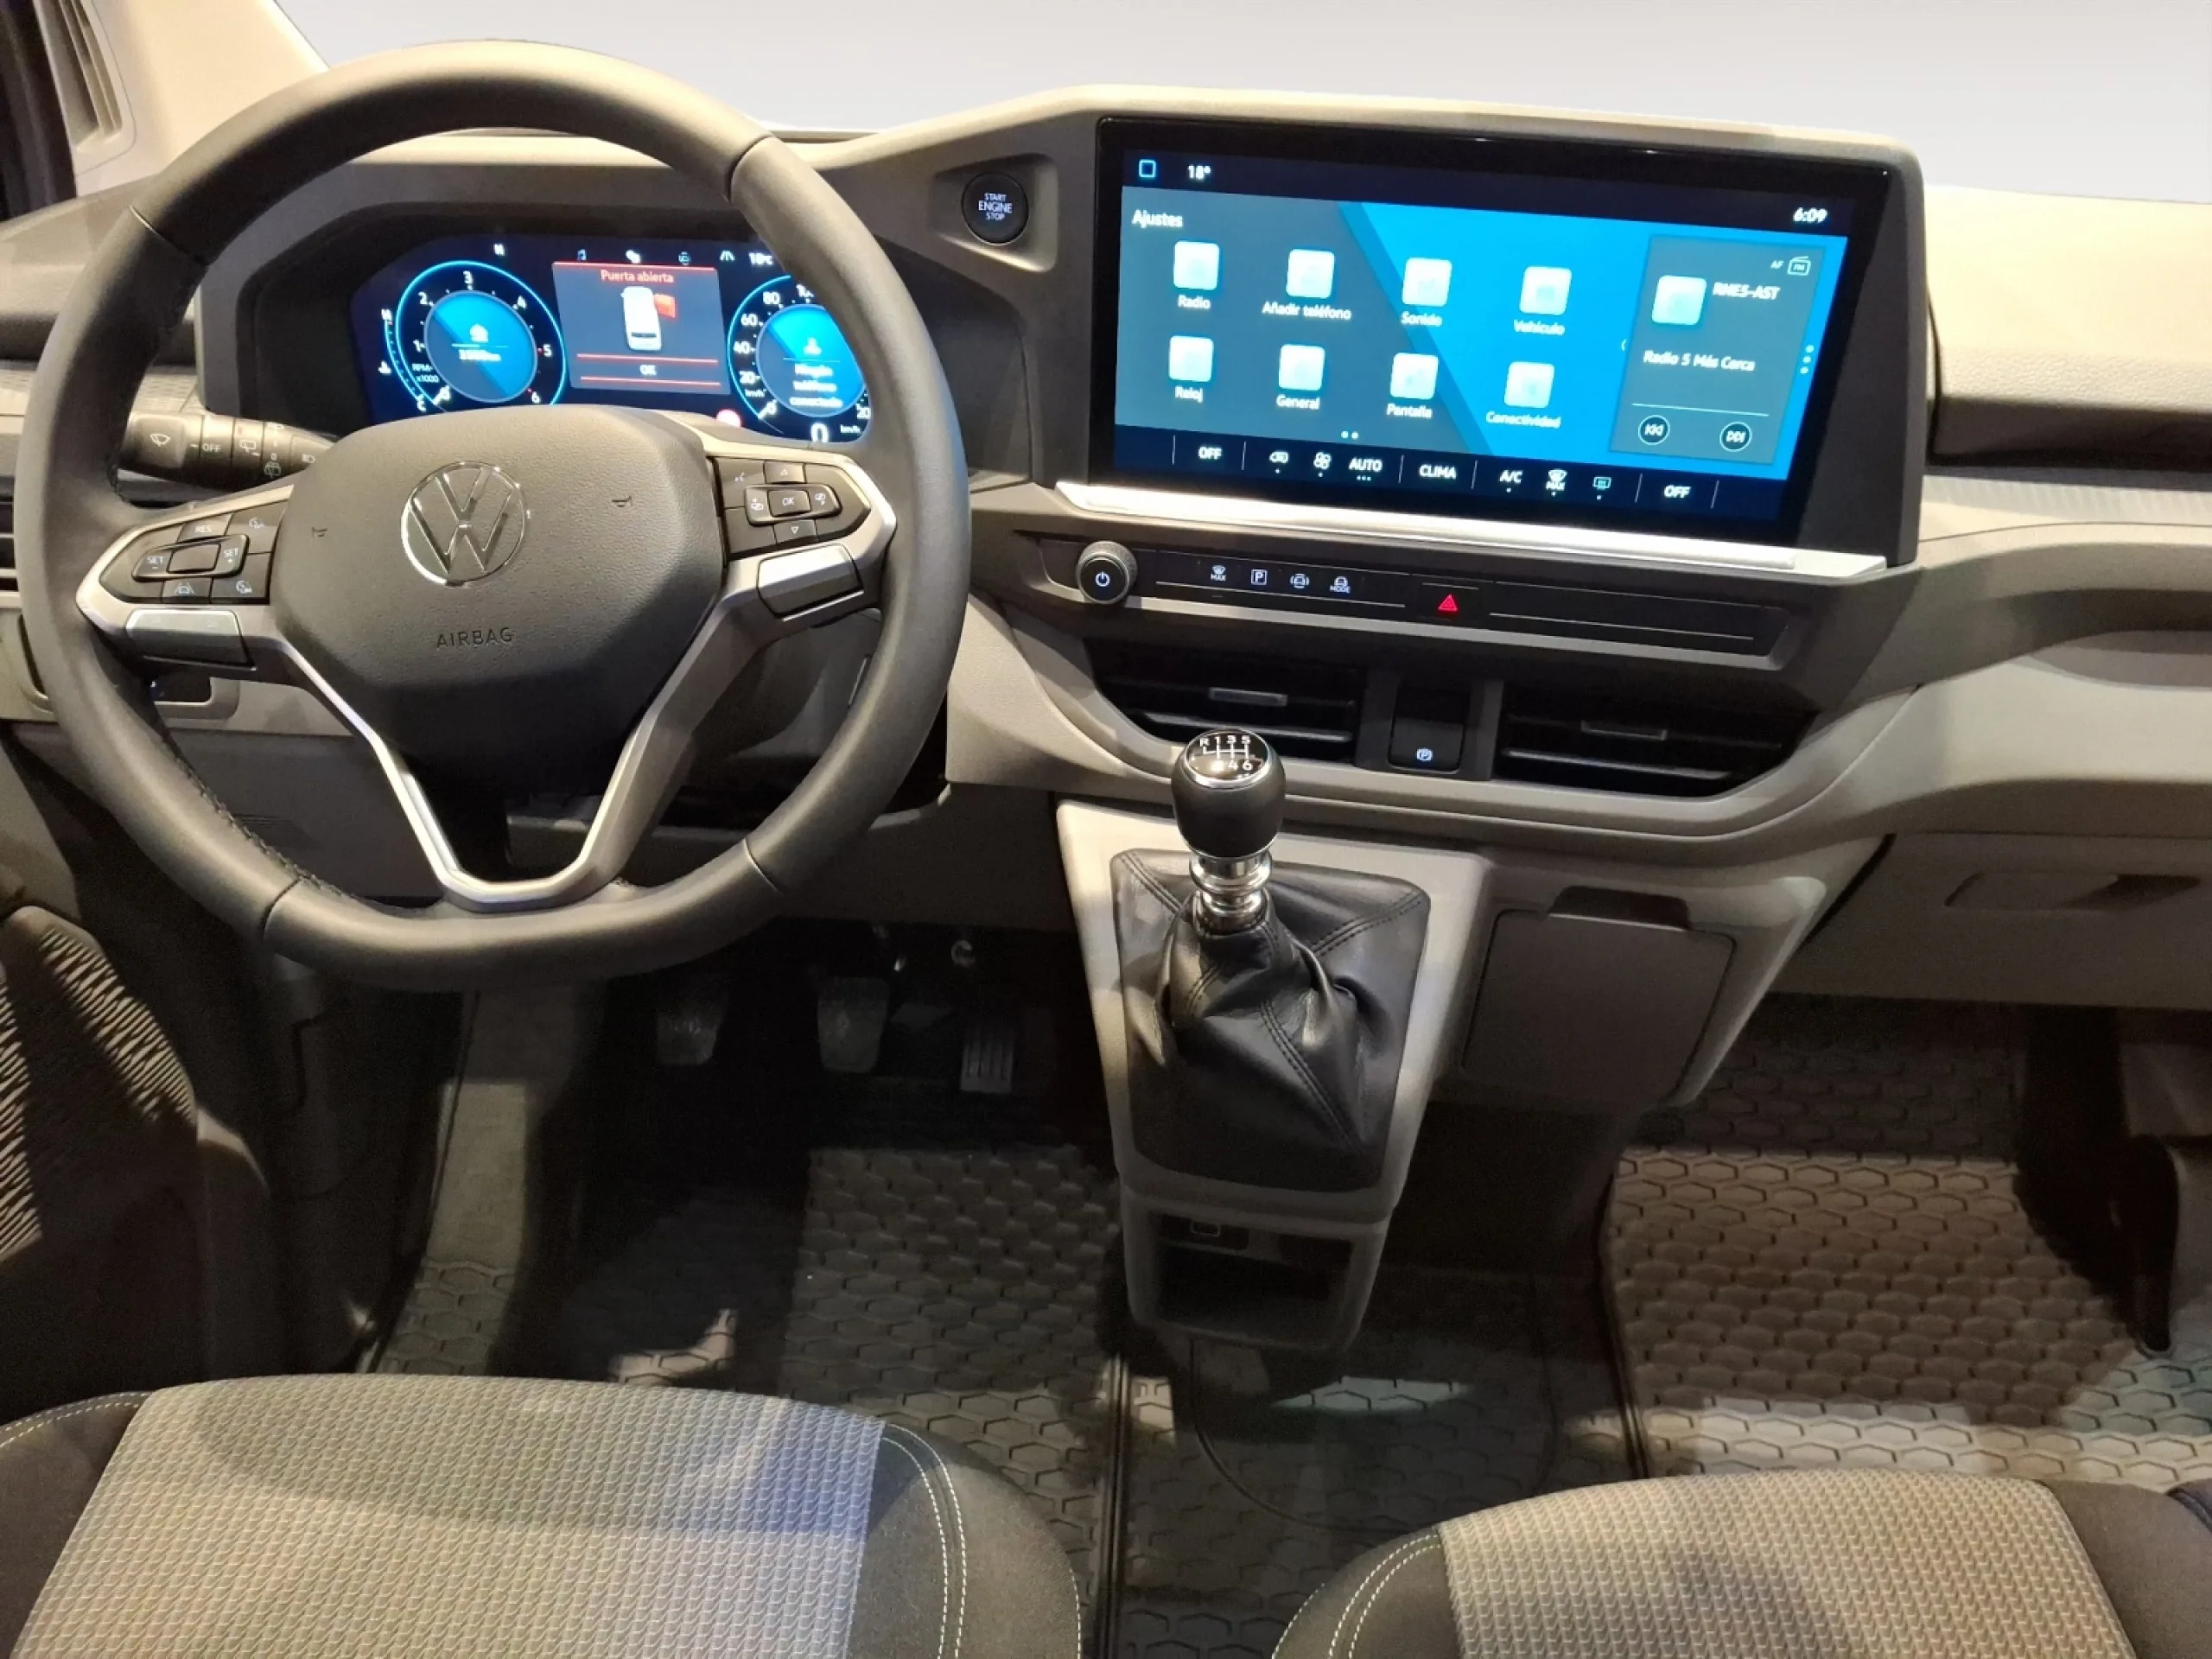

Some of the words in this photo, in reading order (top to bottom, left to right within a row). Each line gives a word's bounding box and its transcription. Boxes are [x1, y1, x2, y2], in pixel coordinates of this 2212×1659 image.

[984, 193, 1007, 201] START
[978, 200, 1013, 213] ENGINE
[986, 212, 1005, 220] STOP
[1132, 210, 1184, 228] Ajustes
[1794, 207, 1827, 222] 6:09
[462, 270, 474, 284] 3
[601, 269, 635, 282] Puerta
[638, 271, 674, 283] abierta
[417, 291, 428, 305] 2
[517, 296, 527, 309] 4
[763, 291, 780, 305] 80
[1178, 295, 1211, 309] Radio
[1262, 301, 1300, 316] Añadir
[1303, 305, 1352, 321] teléfono
[741, 313, 759, 327] 60
[1401, 311, 1443, 327] Sonido
[543, 344, 553, 358] 5
[733, 340, 751, 355] 40
[1643, 350, 1679, 365] Radio
[1681, 352, 1692, 365] 5
[639, 364, 658, 377] OK
[739, 370, 757, 385] 20
[531, 391, 542, 404] 6
[1174, 386, 1204, 404] Reloj
[1276, 394, 1320, 410] General
[202, 443, 221, 452] OFF
[1198, 446, 1222, 460] OFF
[1349, 457, 1382, 473] AUTO
[1419, 464, 1457, 479] CLIMA
[1499, 469, 1523, 484] A/C
[1664, 485, 1691, 499] OFF
[782, 497, 796, 505] OK
[224, 547, 239, 557] SET
[1329, 584, 1351, 594] MODE
[437, 627, 514, 648] AIRBAG
[1199, 737, 1210, 747] R
[1226, 734, 1237, 744] 3
[1241, 734, 1251, 744] 5
[1243, 759, 1253, 771] 6
